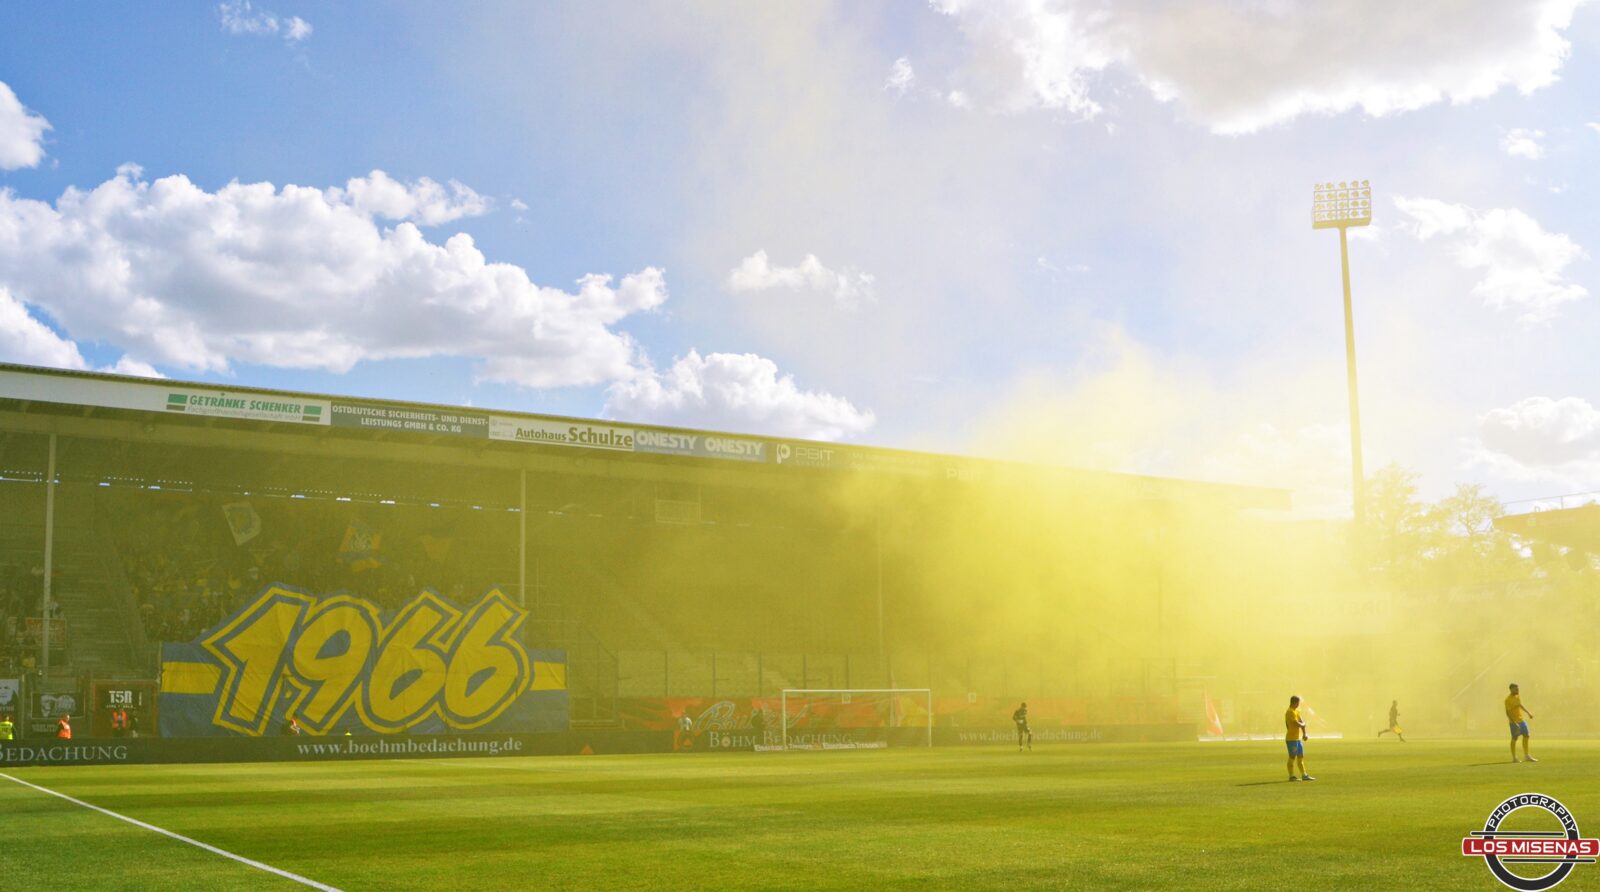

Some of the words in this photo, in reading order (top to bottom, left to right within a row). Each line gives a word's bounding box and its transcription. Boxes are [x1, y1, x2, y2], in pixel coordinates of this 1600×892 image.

[189, 393, 247, 409] GETRÄNKE
[249, 400, 302, 414] SCHENKER
[331, 405, 387, 418] OSTDEUTSCHE
[388, 410, 439, 422] SICHERHEITS-
[441, 415, 457, 423] UND
[459, 417, 489, 425] DIENST-
[360, 417, 402, 428] LEISTUNGS
[404, 421, 427, 430] GMBH
[428, 422, 434, 431] &
[436, 423, 449, 432] CO.
[451, 425, 462, 433] KG
[515, 427, 567, 441] Autohaus
[568, 426, 633, 447] Schulze
[636, 431, 698, 450] ONESTY
[704, 437, 763, 456] ONESTY
[795, 447, 835, 461] PBIT
[201, 586, 531, 735] 1966
[0, 744, 128, 761] EDACHUNG
[297, 737, 522, 755] www.boehmbedachung.de
